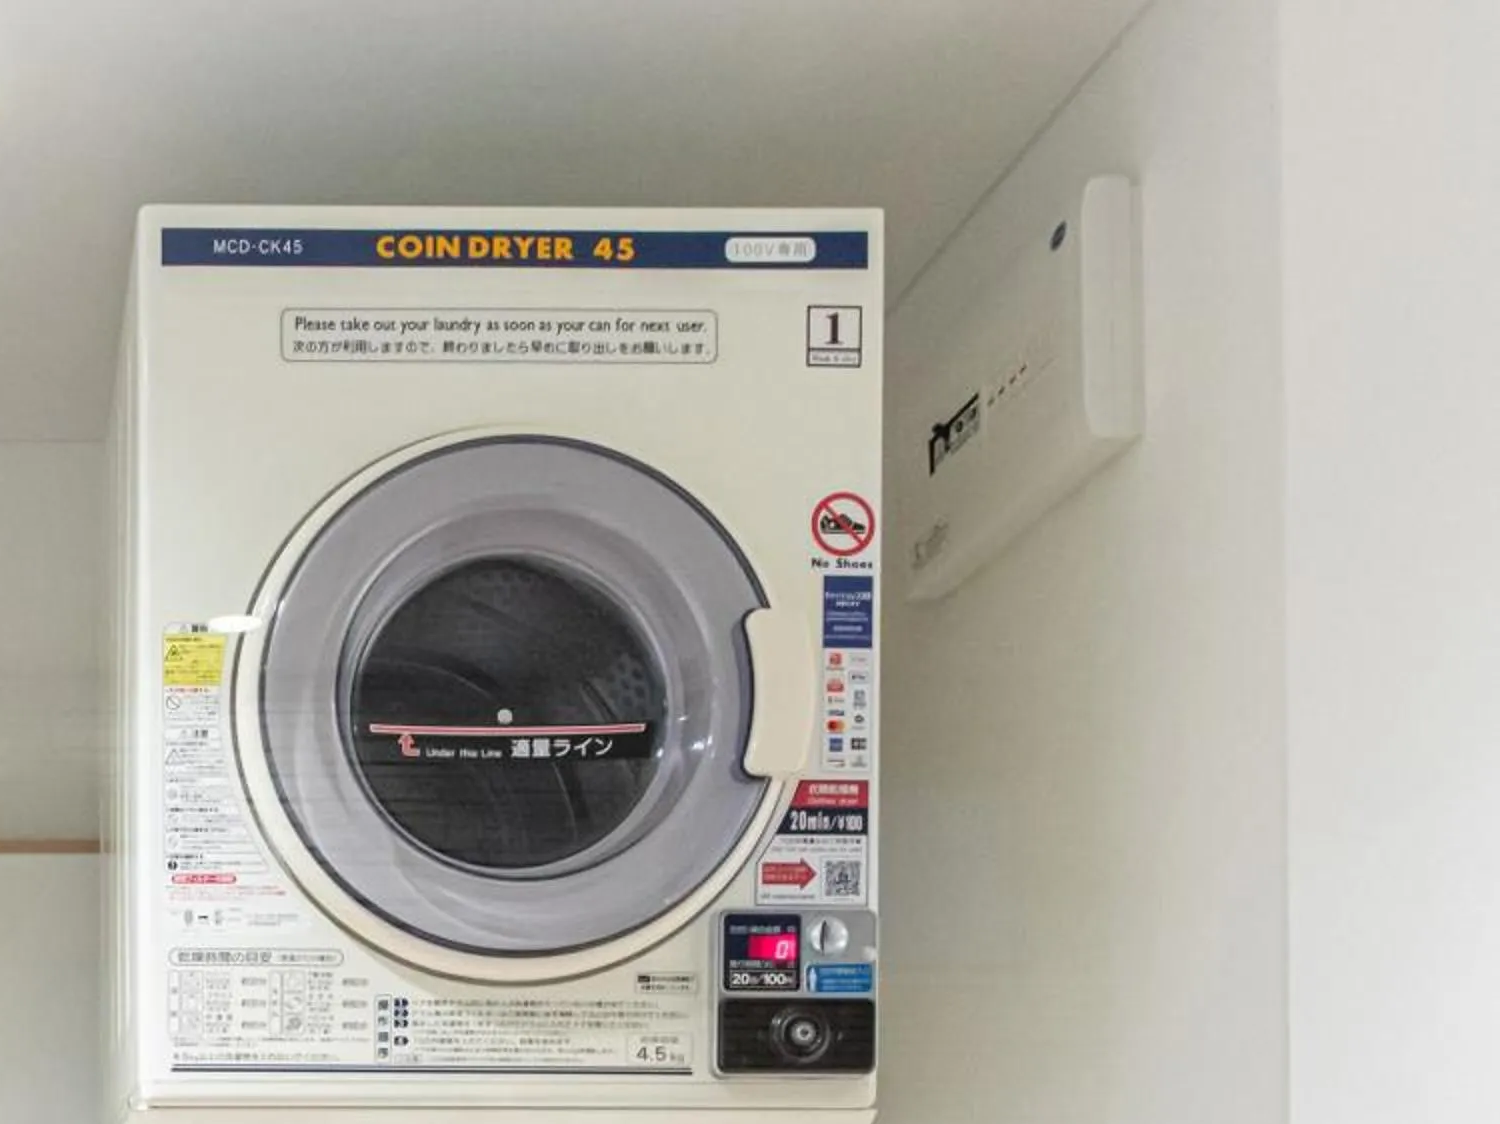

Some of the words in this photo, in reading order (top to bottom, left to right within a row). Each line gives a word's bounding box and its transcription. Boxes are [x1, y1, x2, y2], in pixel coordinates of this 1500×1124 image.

[213, 239, 302, 255] MCD-CK45
[376, 236, 463, 258] COIN
[469, 236, 573, 259] DRYER
[593, 237, 635, 261] 45
[295, 317, 336, 331] Please
[340, 318, 369, 331] take
[373, 319, 396, 331] out
[399, 319, 429, 335] your
[433, 317, 481, 335] laundry
[486, 320, 499, 332] as
[503, 320, 535, 332] soon
[539, 320, 552, 332] as
[556, 320, 586, 336] your
[589, 320, 611, 332] can
[615, 317, 635, 332] for
[640, 319, 670, 332] next
[676, 320, 707, 332] user.
[825, 312, 845, 344] 1
[811, 558, 830, 569] No
[836, 558, 873, 569] Shoes
[510, 738, 613, 758] 適量ライン
